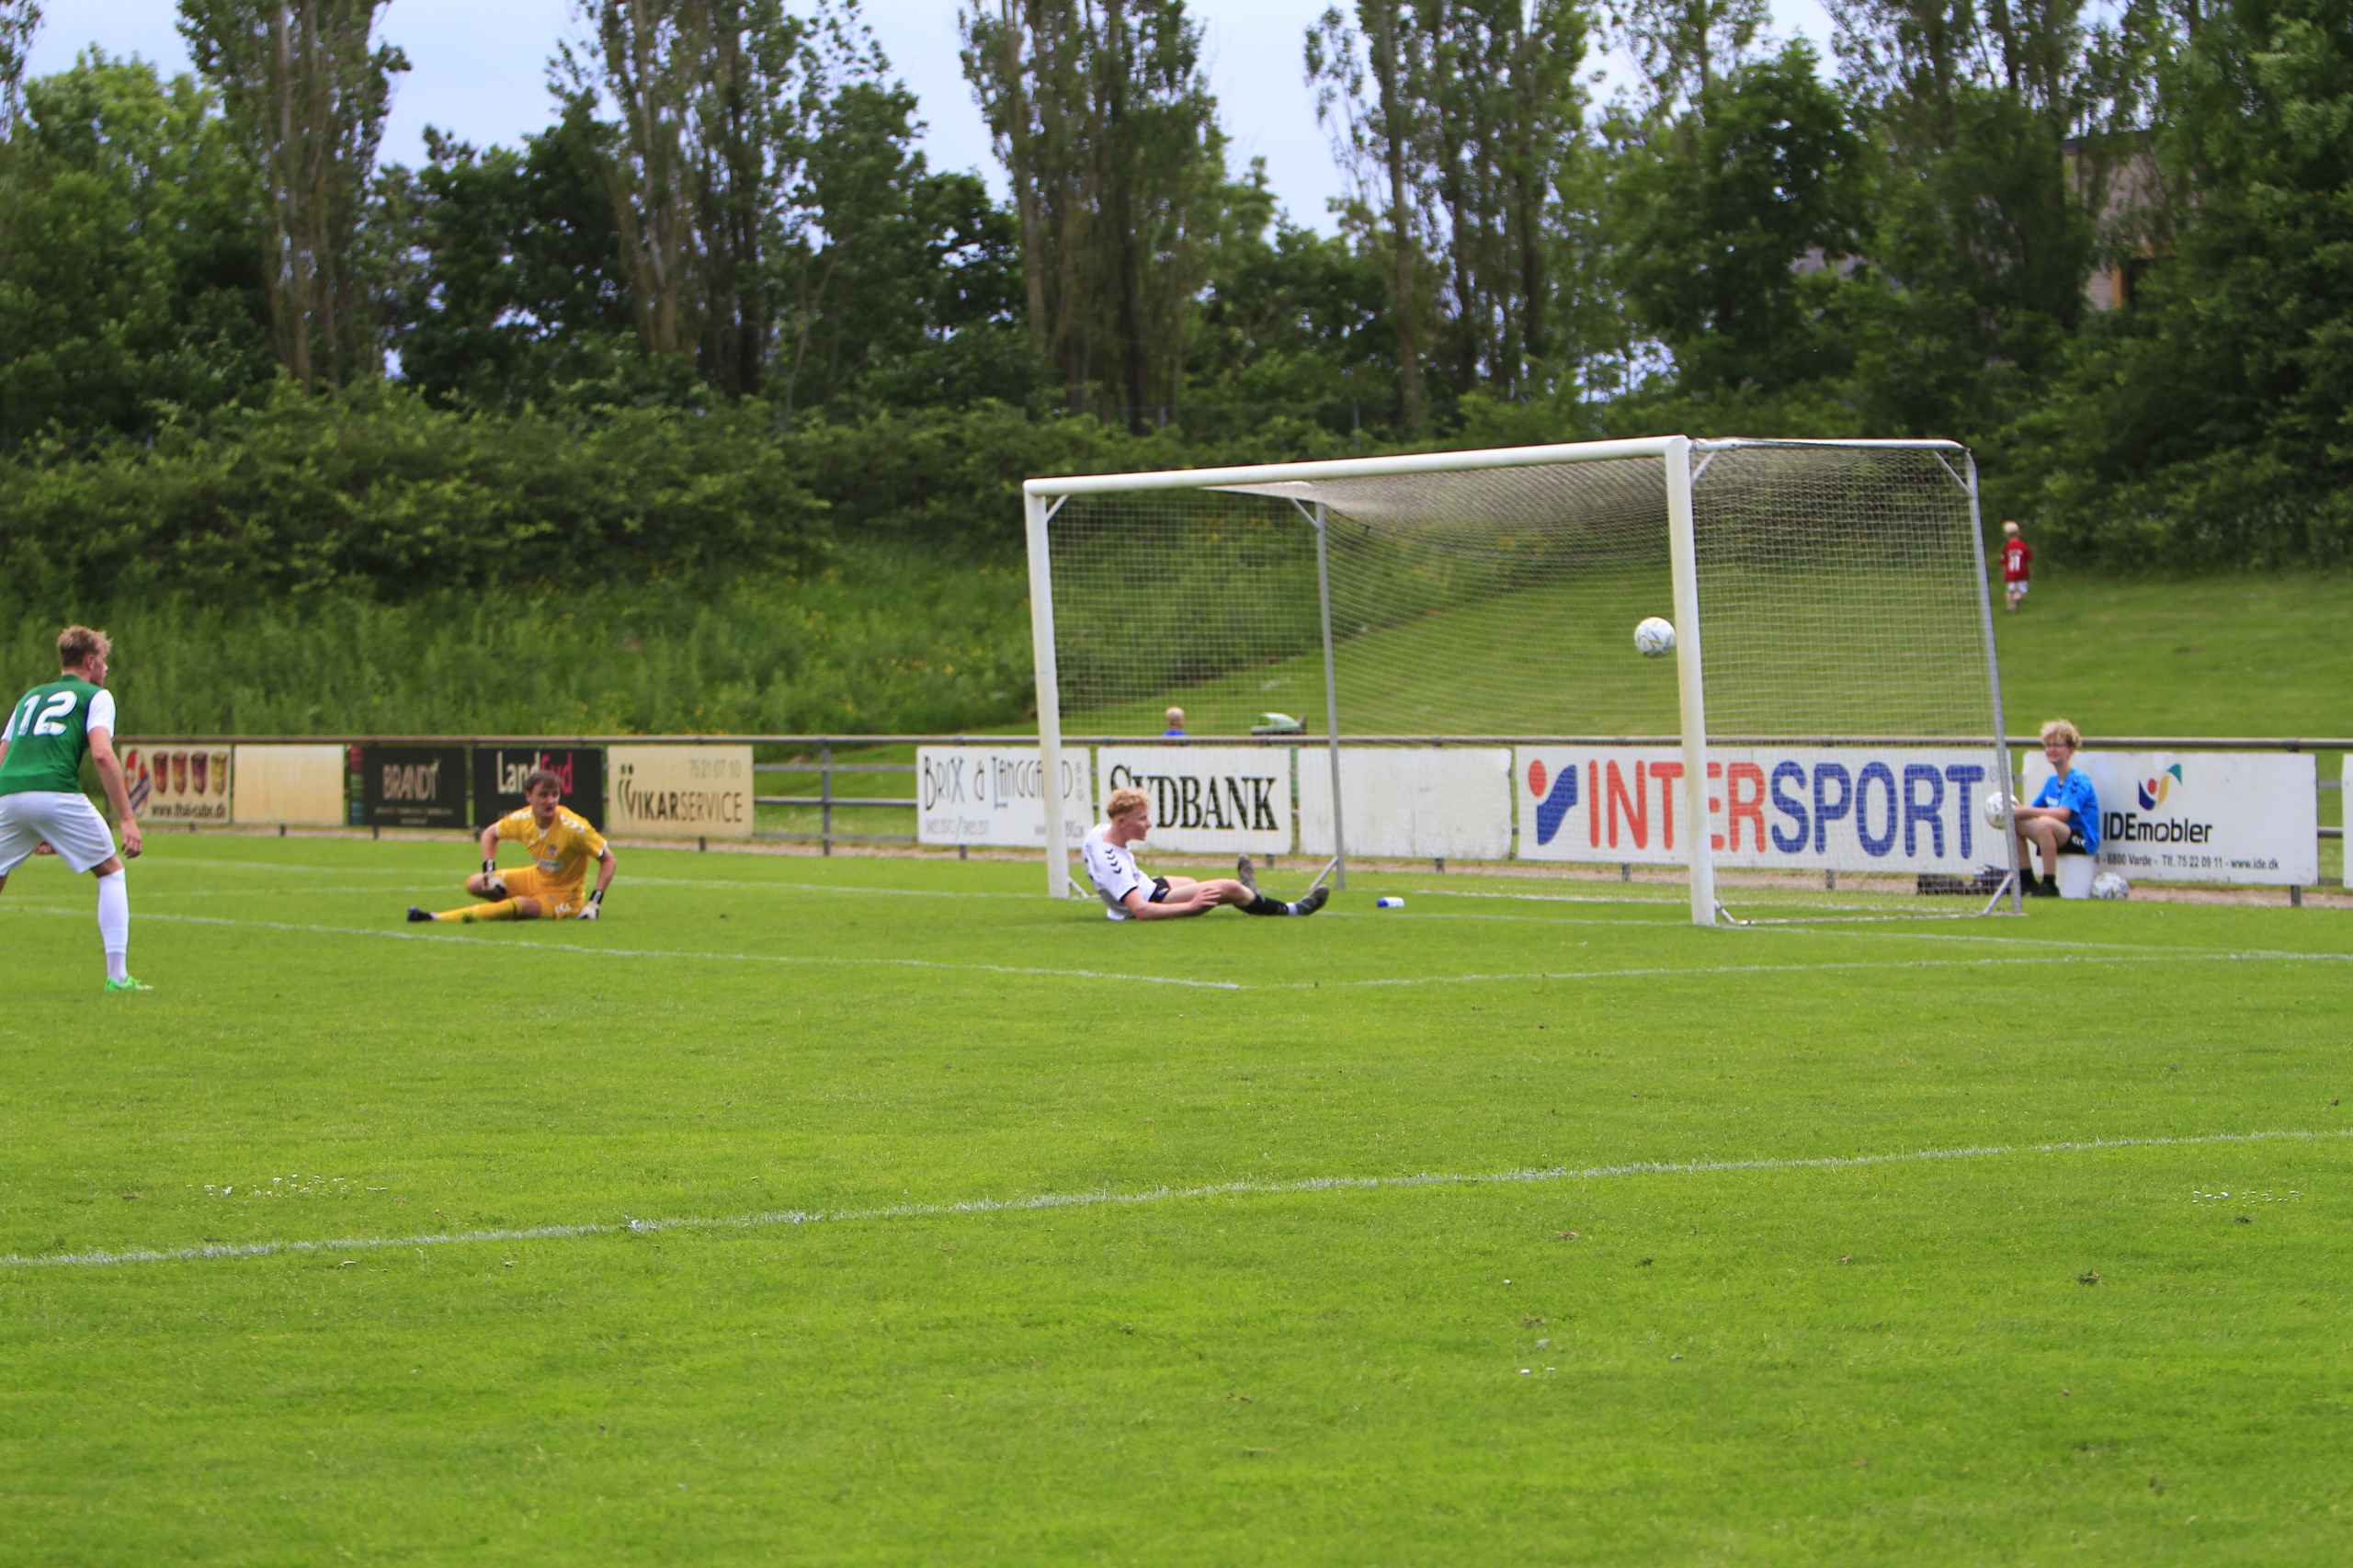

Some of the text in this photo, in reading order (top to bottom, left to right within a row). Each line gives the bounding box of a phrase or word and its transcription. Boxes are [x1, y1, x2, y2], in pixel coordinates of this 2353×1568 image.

[18, 690, 77, 736] 12
[2128, 853, 2152, 866] Varde
[2177, 855, 2187, 867] 75
[2189, 855, 2199, 868] 22
